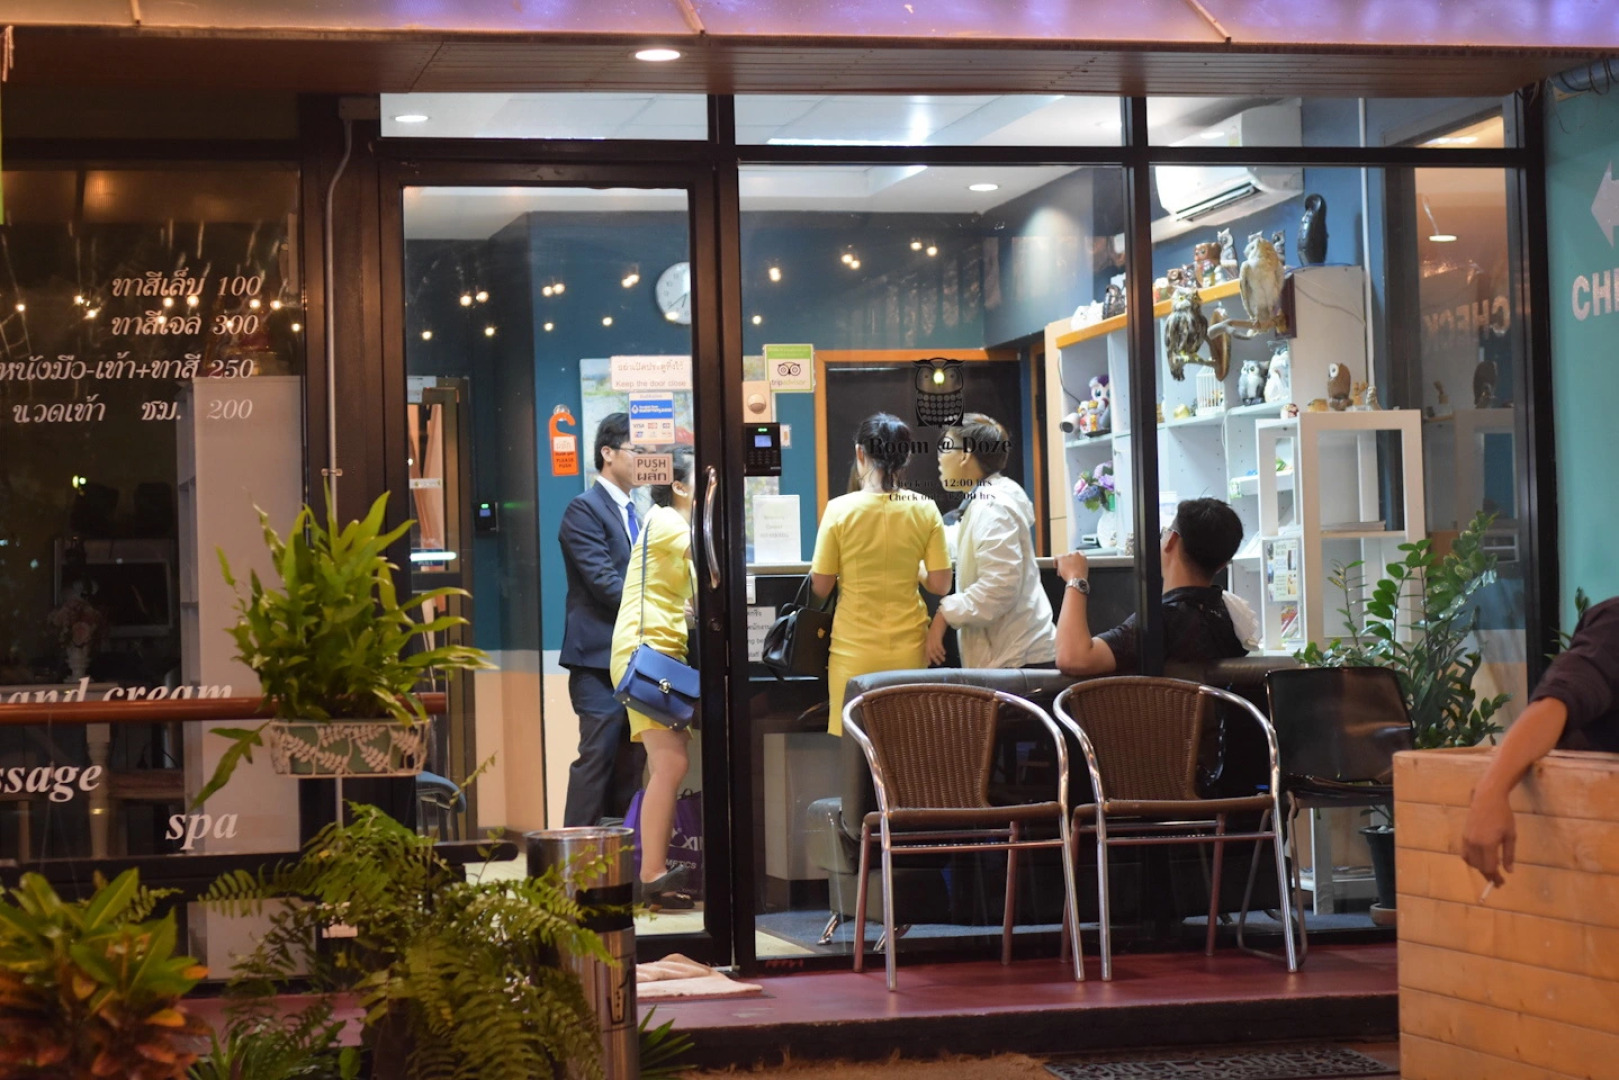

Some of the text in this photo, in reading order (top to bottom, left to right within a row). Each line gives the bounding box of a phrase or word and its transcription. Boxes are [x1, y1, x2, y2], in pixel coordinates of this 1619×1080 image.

[217, 276, 261, 296] 100
[213, 314, 259, 335] 300
[208, 358, 254, 379] 250
[207, 399, 253, 420] 200
[869, 436, 1012, 454] Room @ Doze
[637, 458, 666, 468] PUSH
[637, 468, 667, 481] ผลัก
[944, 478, 973, 488] 12:00
[889, 492, 918, 502] Check
[0, 765, 103, 803] sage
[165, 812, 238, 850] spa
